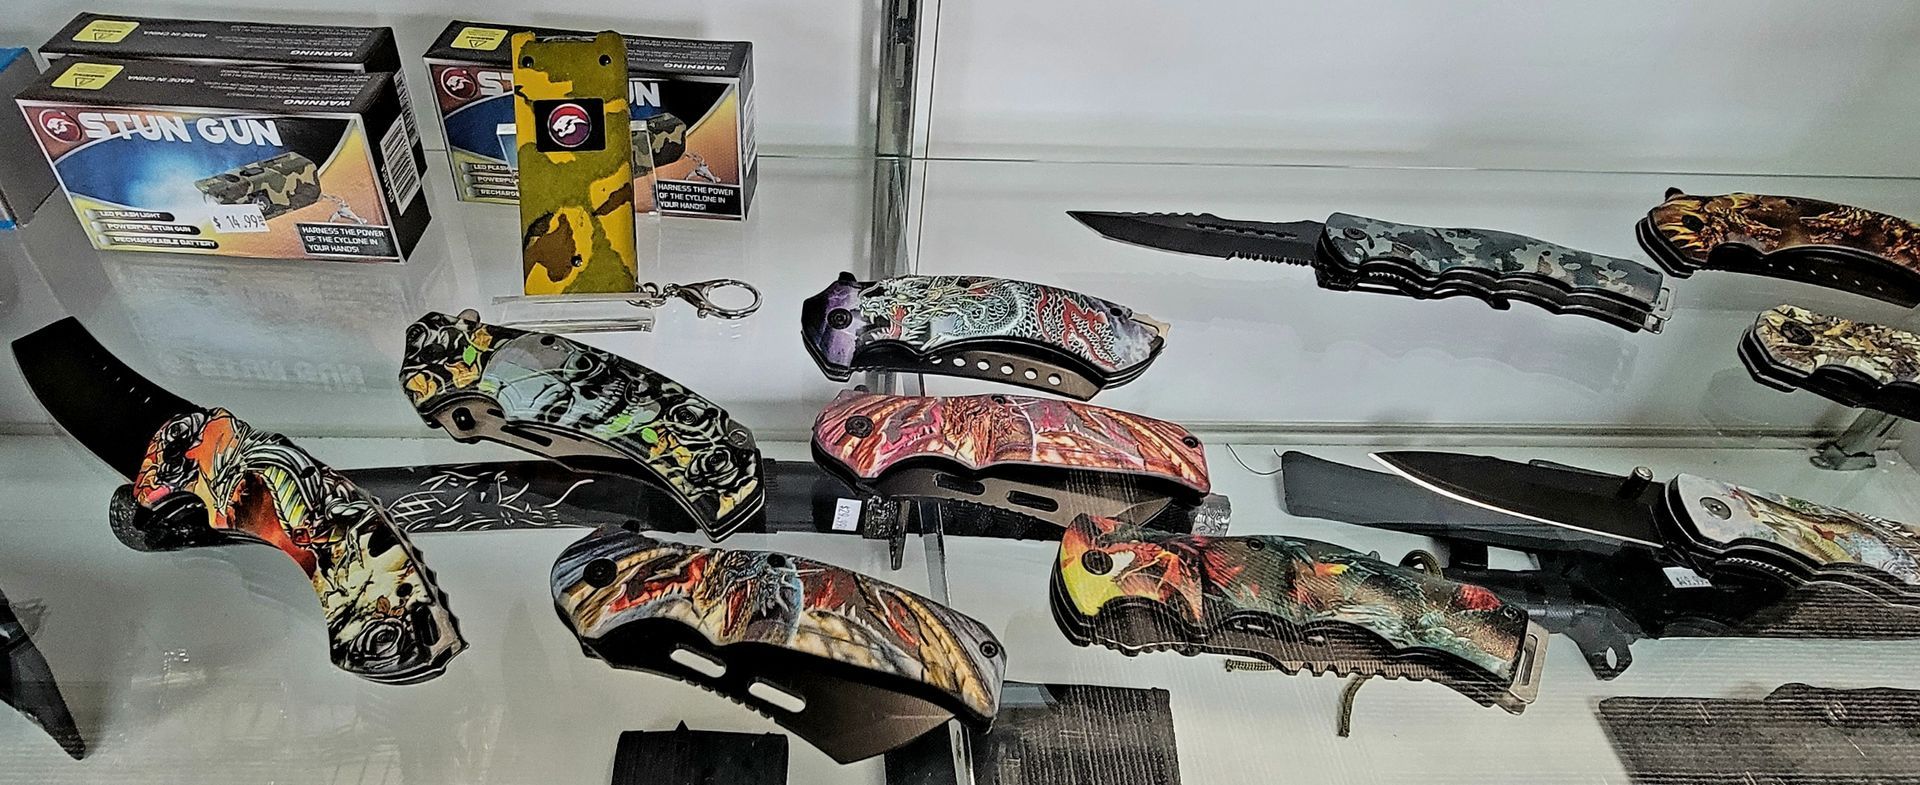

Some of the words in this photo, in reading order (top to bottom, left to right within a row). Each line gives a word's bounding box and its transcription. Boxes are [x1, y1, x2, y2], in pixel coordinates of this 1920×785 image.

[290, 49, 354, 57] WARNING
[663, 62, 726, 71] WARNING
[283, 98, 351, 107] WARNING
[77, 111, 193, 143] STUN
[196, 117, 284, 148] GUN
[658, 183, 692, 192] HARNESS
[692, 185, 707, 194] THE
[708, 187, 734, 196] POWER
[669, 192, 685, 200] THE
[685, 194, 717, 203] CYCLONE
[717, 196, 726, 204] IN
[106, 223, 153, 231] POWERFUL
[301, 226, 340, 235] HARNESS
[339, 228, 357, 236] THE
[356, 229, 385, 238] POWER
[112, 236, 180, 245] RECHARGEABLE
[179, 239, 215, 248] BATTERY
[316, 236, 333, 244] THE
[333, 237, 369, 245] CYCLONE
[369, 238, 379, 246] IN
[308, 244, 330, 252] YOUR
